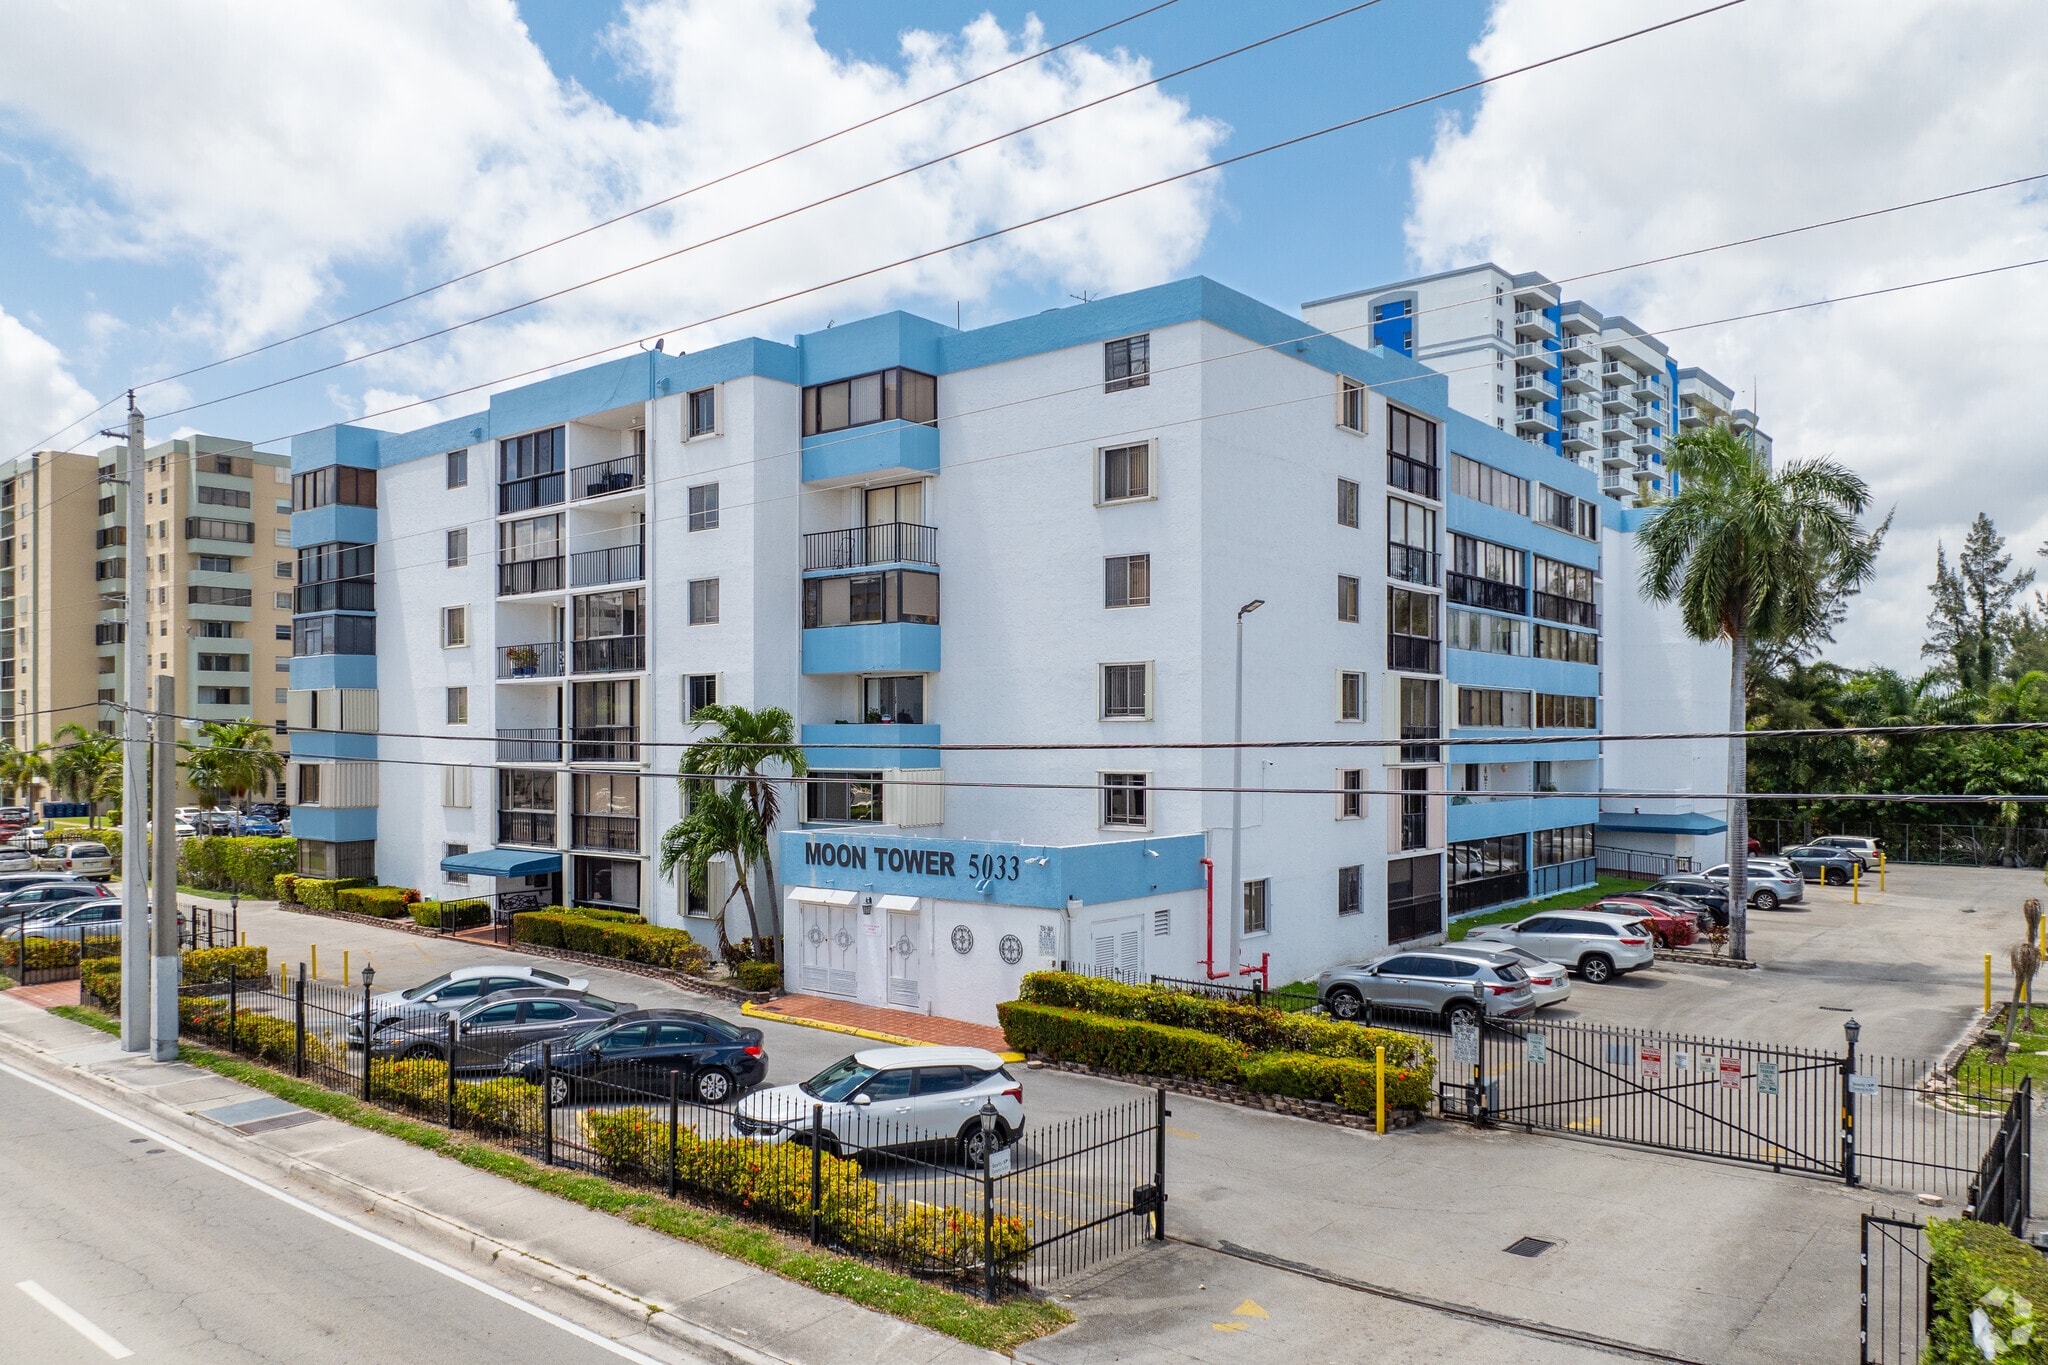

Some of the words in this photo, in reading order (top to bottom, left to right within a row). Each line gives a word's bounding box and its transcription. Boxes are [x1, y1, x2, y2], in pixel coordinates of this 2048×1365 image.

[805, 842, 867, 870] MOON
[873, 847, 956, 877] TOWER
[968, 853, 1020, 881] 5033
